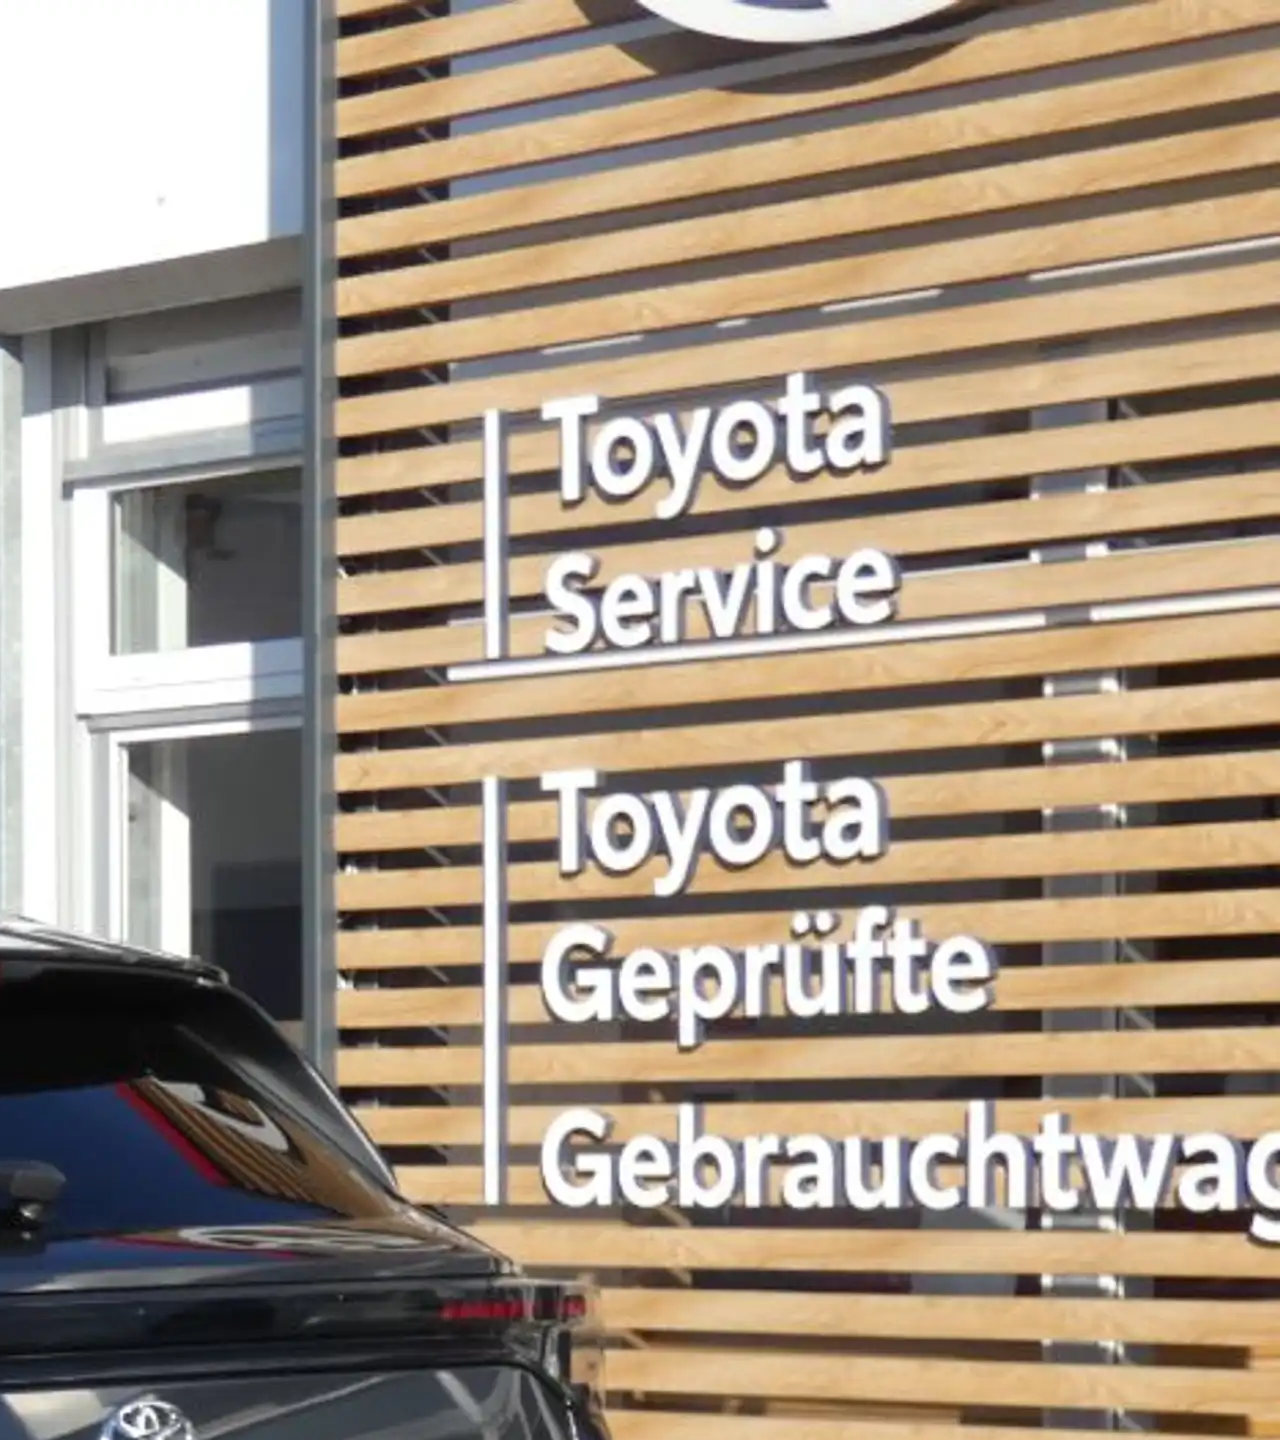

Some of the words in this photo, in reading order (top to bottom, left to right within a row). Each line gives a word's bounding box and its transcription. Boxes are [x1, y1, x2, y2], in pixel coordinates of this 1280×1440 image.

[542, 372, 886, 519] Toyota
[543, 527, 896, 655] Service
[540, 760, 884, 896] Toyota
[540, 905, 993, 1048] Geprüfte
